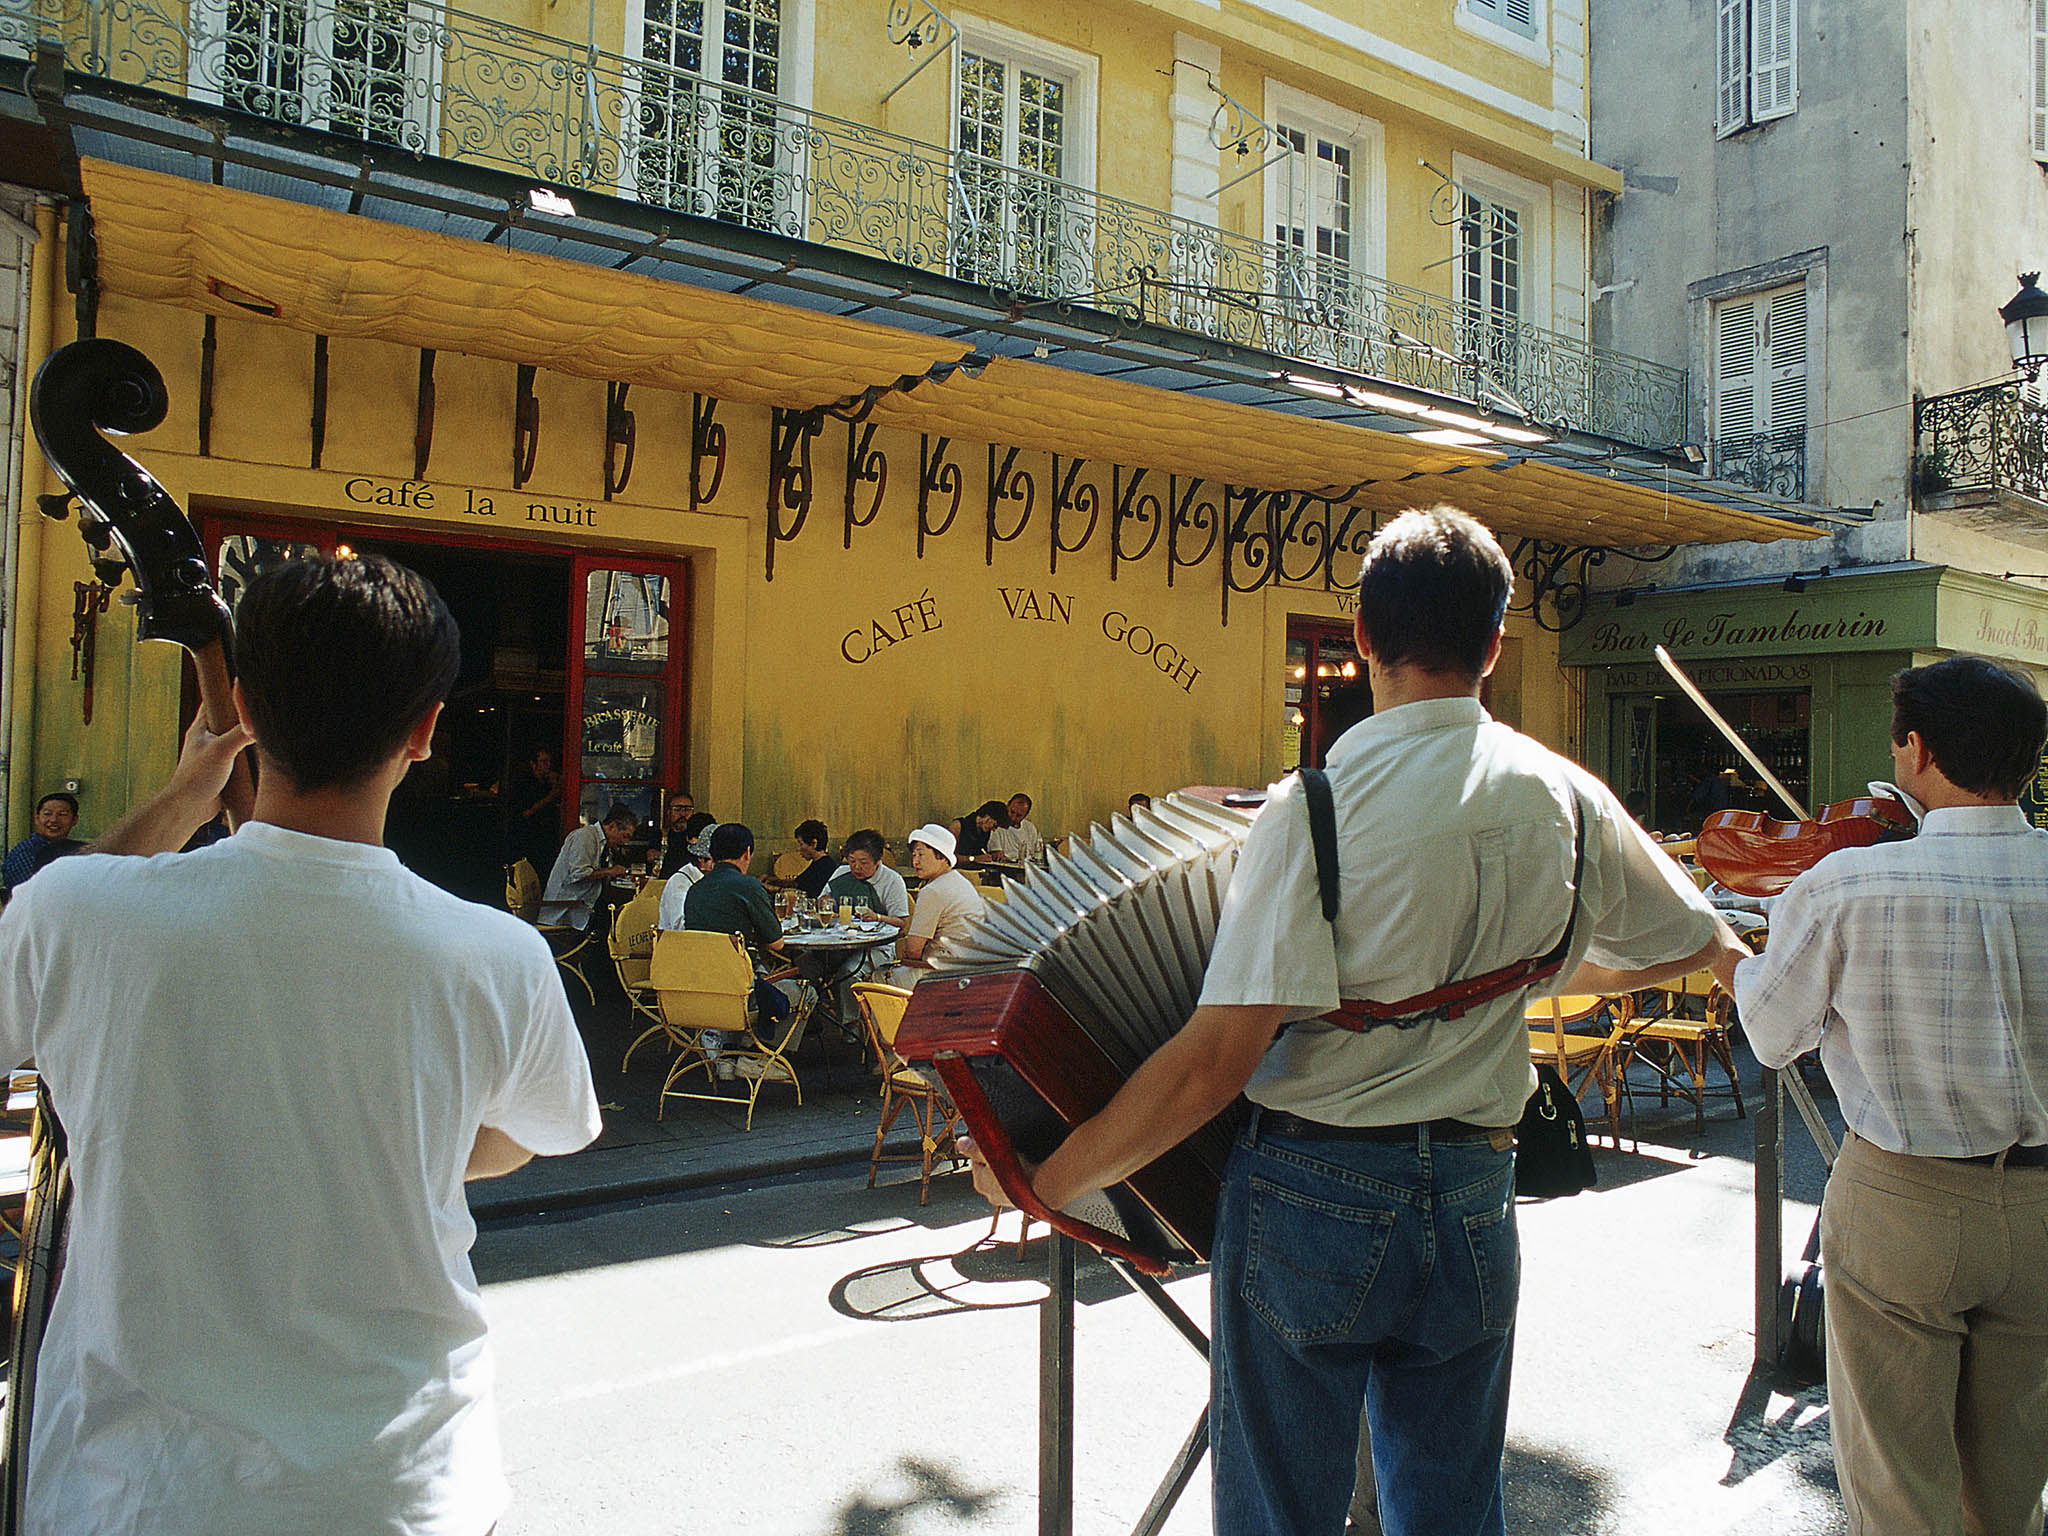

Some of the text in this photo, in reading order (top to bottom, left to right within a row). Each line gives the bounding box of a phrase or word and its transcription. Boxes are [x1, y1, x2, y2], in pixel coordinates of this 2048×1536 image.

[344, 478, 598, 527] Café la nuit
[841, 587, 1202, 695] CAFÉ VAN GOGH
[1592, 609, 1888, 652] Bar Le Tambourin
[1976, 607, 2048, 651] Snack Ba
[1606, 670, 1637, 687] BAR
[583, 708, 660, 729] BRASSERIE
[587, 740, 600, 753] Le
